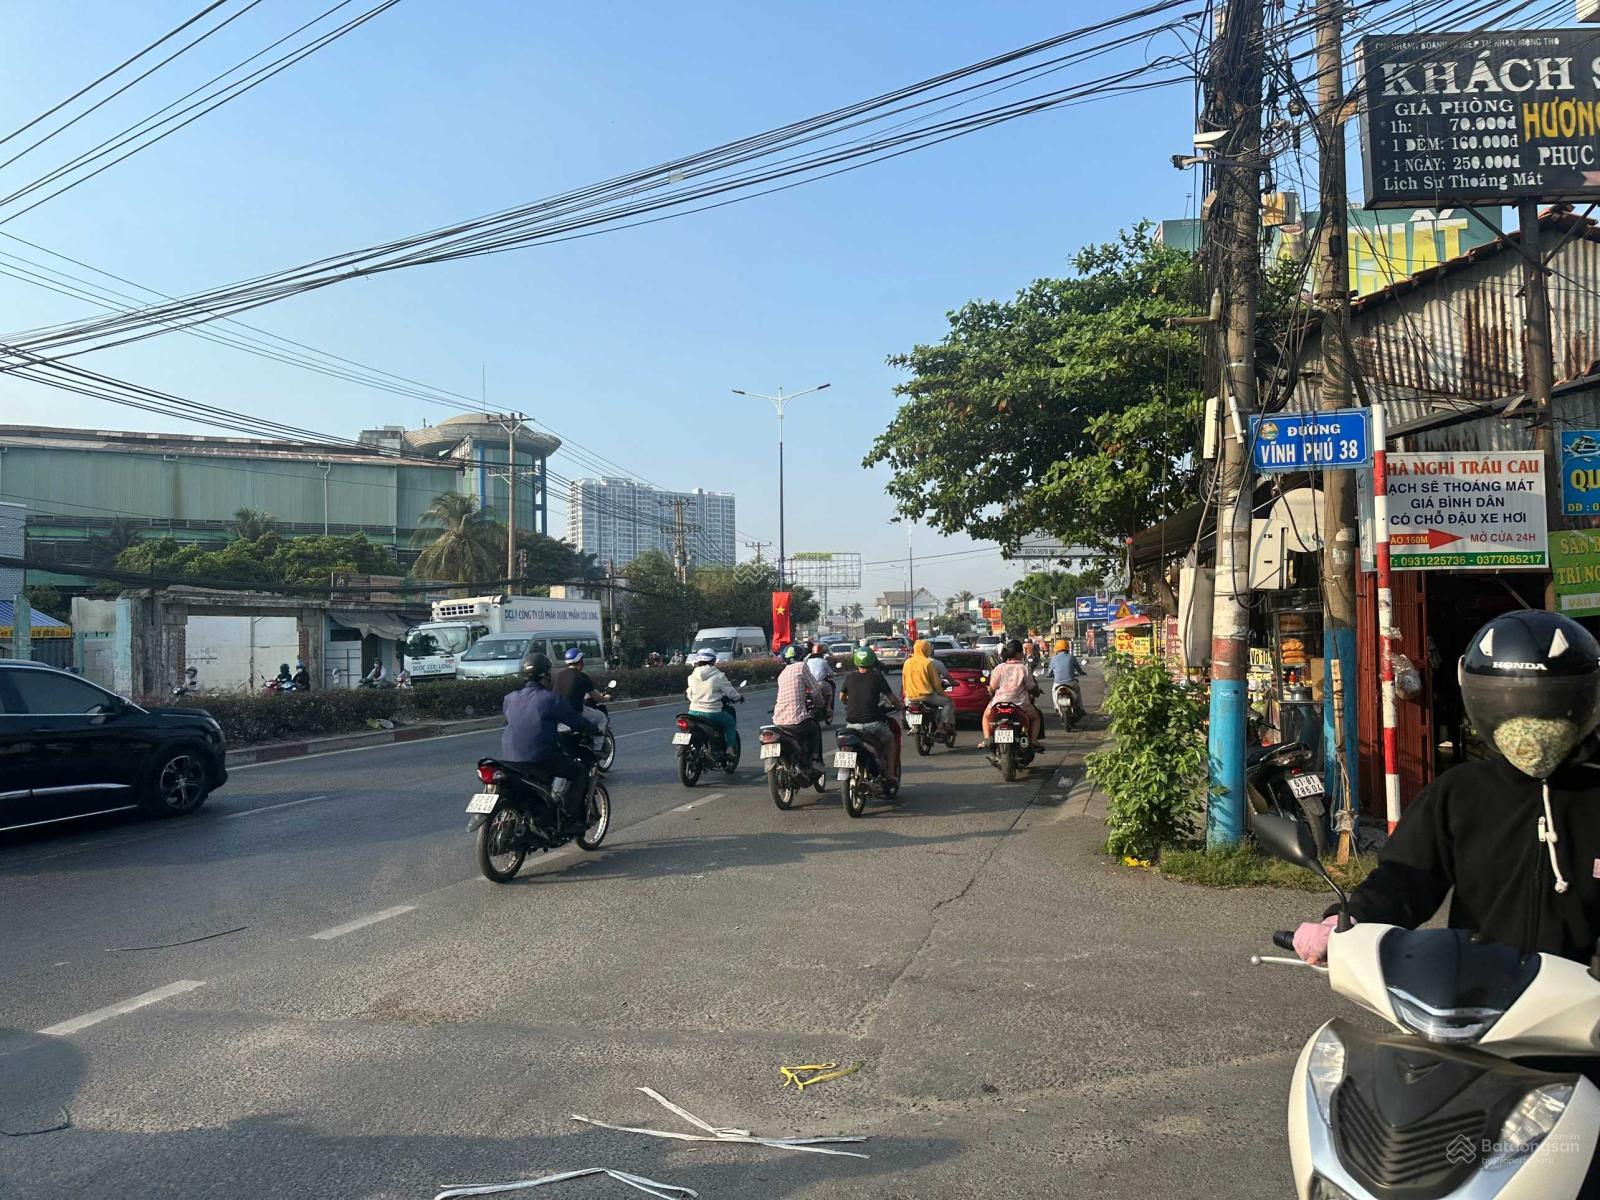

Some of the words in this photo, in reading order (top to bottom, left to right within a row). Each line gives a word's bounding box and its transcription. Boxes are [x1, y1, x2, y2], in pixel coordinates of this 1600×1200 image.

[1380, 49, 1575, 96] KHÁCH
[1394, 98, 1433, 116] GIÁ
[1440, 96, 1514, 115] PHÒNG
[1390, 119, 1412, 134] 1h:
[1392, 139, 1401, 152] 1
[1393, 159, 1400, 173] 1
[1404, 154, 1446, 172] NGÀY:
[1537, 144, 1595, 170] PHỤC
[1383, 176, 1418, 194] Lịch
[1423, 175, 1445, 192] Sự
[1448, 173, 1508, 191] Thoáng
[1512, 171, 1544, 186] Mát
[1287, 422, 1341, 437] ĐƯỜNG
[1261, 440, 1296, 464] VĨNH
[1303, 437, 1333, 462] PHÚ
[1339, 439, 1358, 460] 38
[1507, 459, 1539, 474] CAU
[1388, 482, 1417, 496] ẠCH
[1443, 479, 1501, 493] THOÁNG
[1505, 478, 1535, 492] MÁT
[1410, 495, 1435, 509] GIÁ
[1439, 495, 1472, 508] BÌNH
[1476, 495, 1505, 508] DÂN
[1390, 512, 1411, 526] CÓ
[1414, 509, 1444, 525] CHỖ
[1448, 512, 1476, 526] ĐẬU
[1480, 513, 1499, 524] XE
[1503, 511, 1527, 524] HƠI
[1516, 533, 1536, 542] 24H
[1401, 555, 1466, 567] 0931225736
[1476, 554, 1542, 565] 0377085217
[1491, 661, 1548, 671] HONDA
